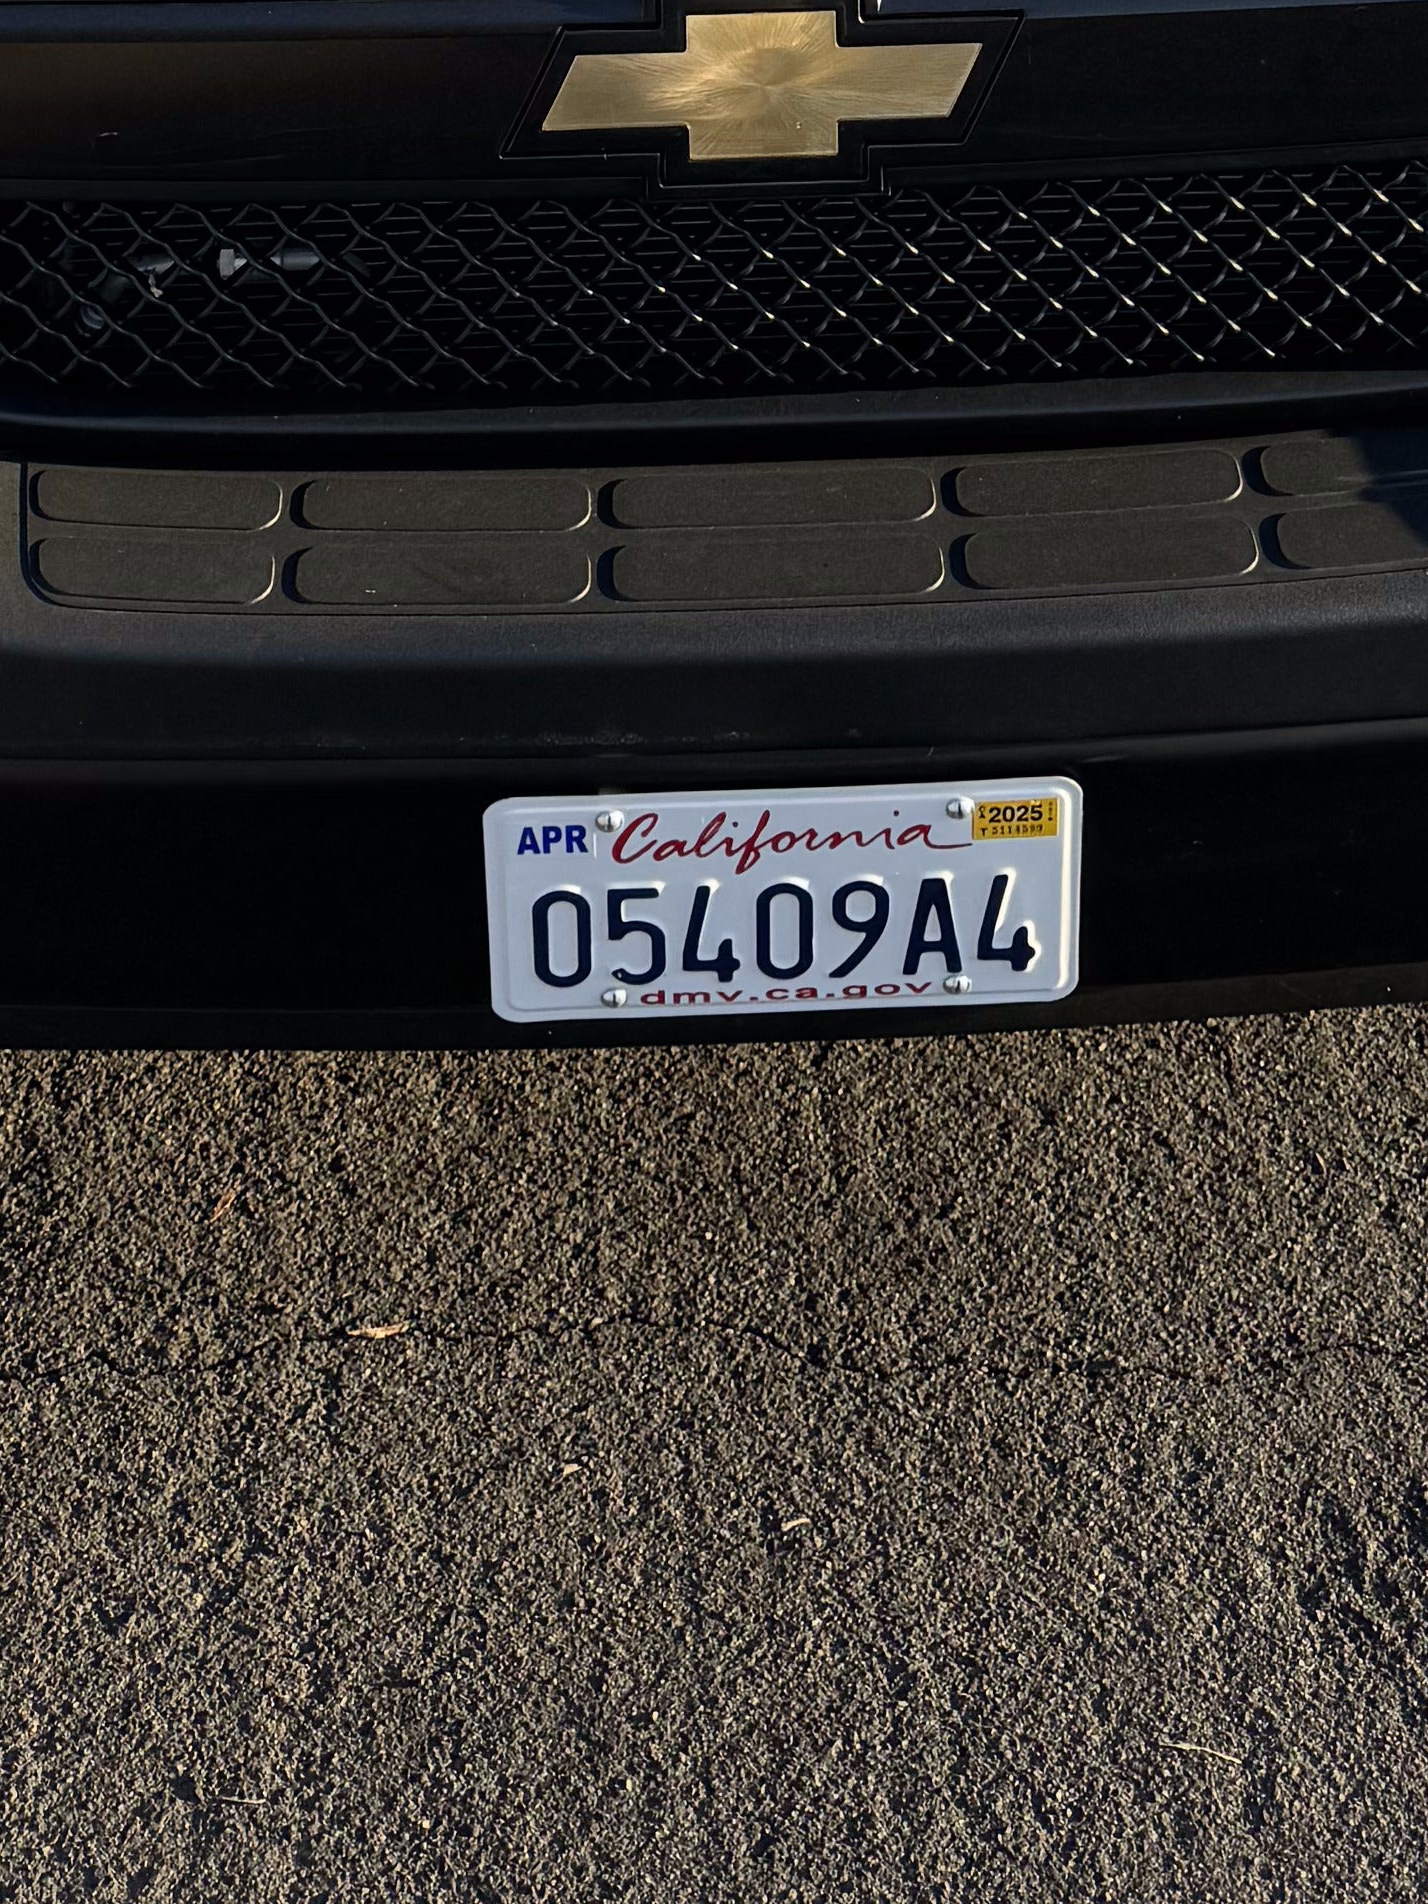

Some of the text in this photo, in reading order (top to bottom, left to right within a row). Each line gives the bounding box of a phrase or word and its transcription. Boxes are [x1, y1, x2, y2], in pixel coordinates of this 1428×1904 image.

[988, 804, 1043, 824] 2025
[518, 825, 588, 855] APR
[612, 809, 972, 874] California
[532, 875, 1036, 988] 05409A4
[640, 980, 933, 1006] dmv.ca.gov
